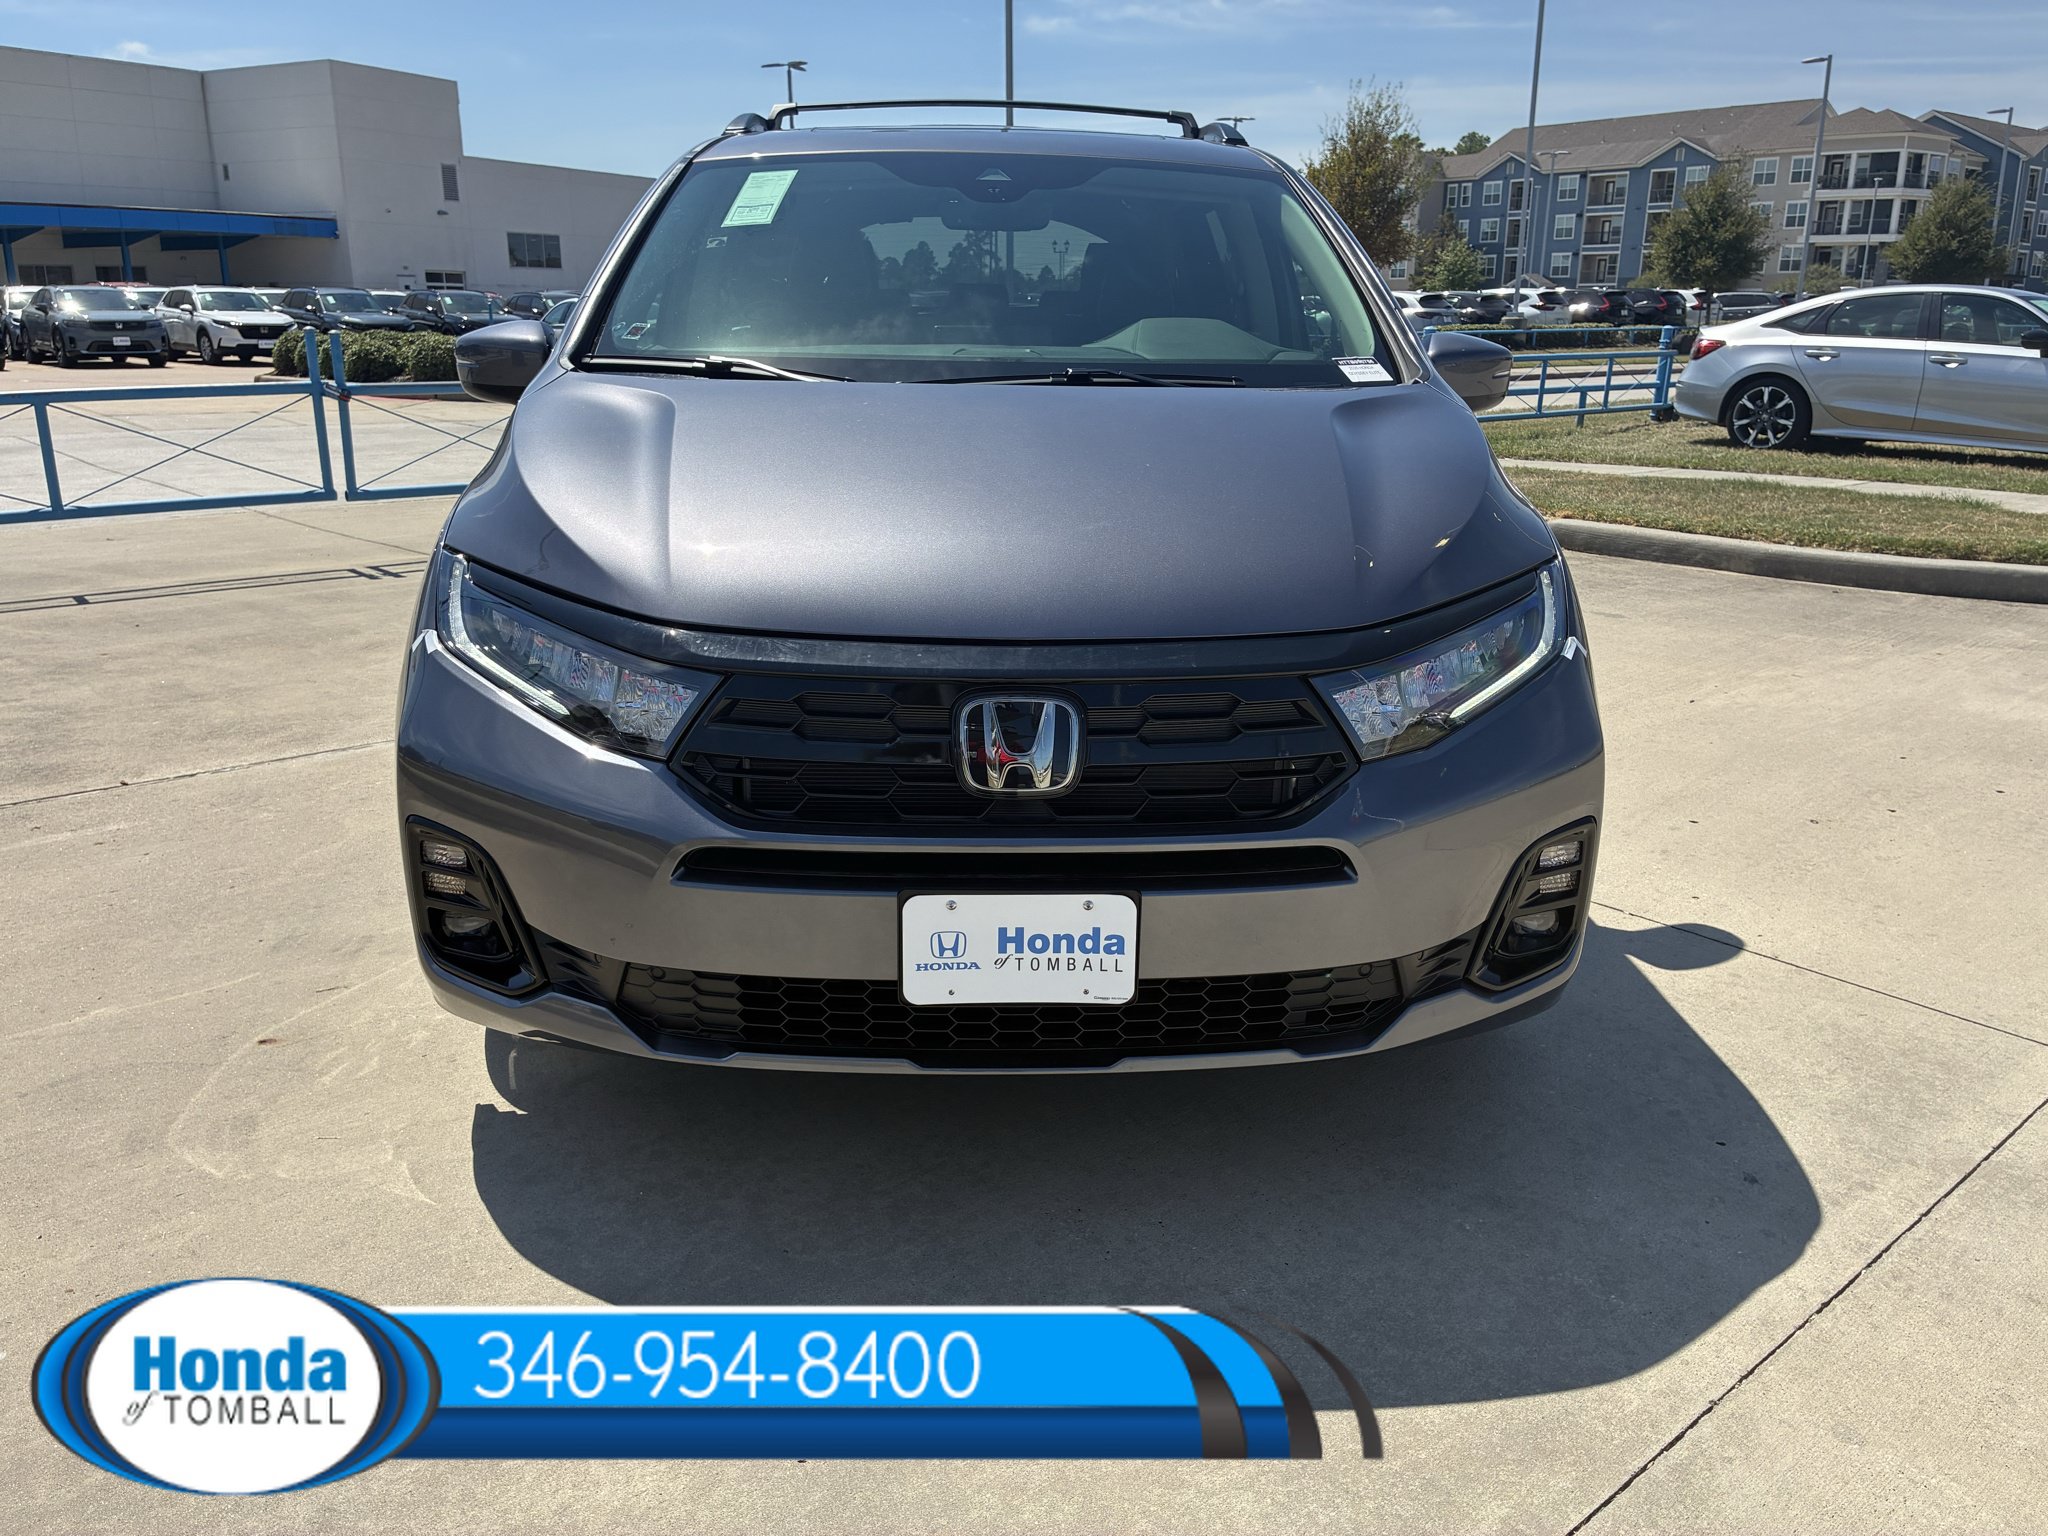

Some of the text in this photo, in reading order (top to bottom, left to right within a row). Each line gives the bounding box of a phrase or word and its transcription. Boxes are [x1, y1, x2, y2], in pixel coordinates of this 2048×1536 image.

[997, 926, 1125, 955] Honda
[915, 961, 982, 972] HONDA
[994, 953, 1123, 972] of TOMBALL
